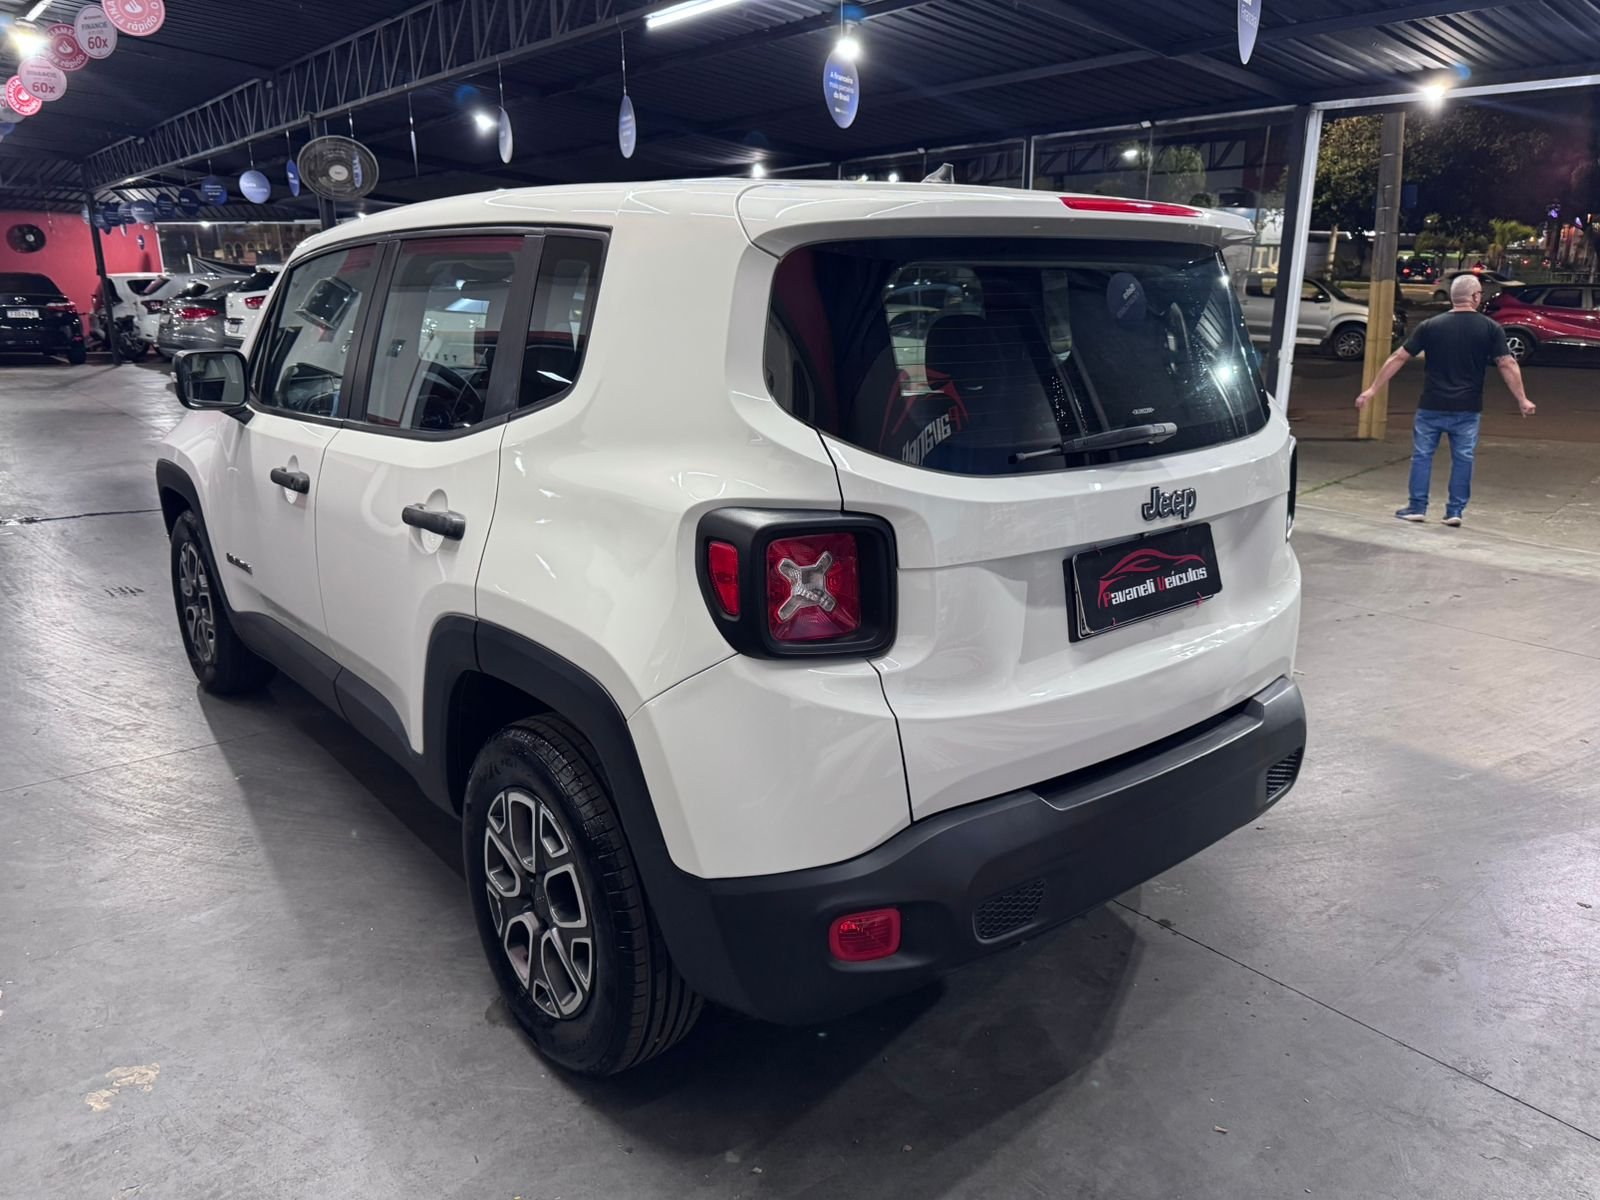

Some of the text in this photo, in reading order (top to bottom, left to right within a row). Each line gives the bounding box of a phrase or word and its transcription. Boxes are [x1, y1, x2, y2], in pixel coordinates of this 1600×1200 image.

[127, 15, 157, 32] rápido
[87, 36, 108, 49] 60x
[32, 82, 56, 94] 60x
[1142, 486, 1197, 521] Jeep
[1103, 577, 1156, 608] Pavaneli
